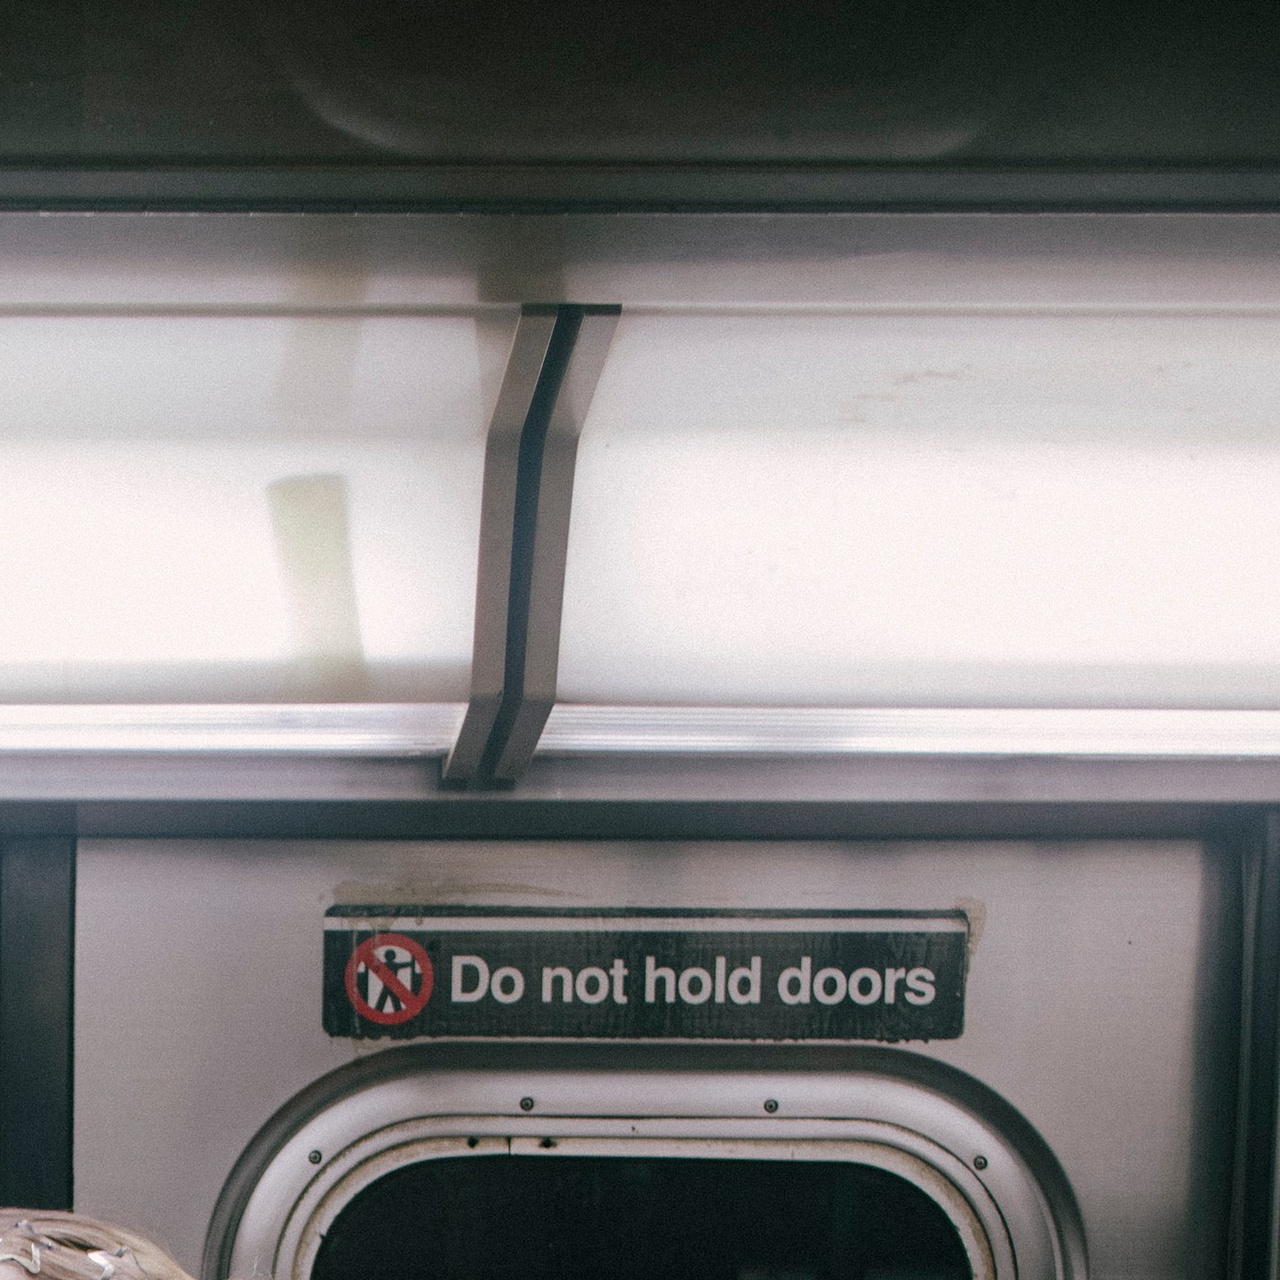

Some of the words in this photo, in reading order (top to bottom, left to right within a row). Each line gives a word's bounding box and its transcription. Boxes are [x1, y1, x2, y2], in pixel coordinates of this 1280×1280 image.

[451, 955, 525, 1004] Do
[541, 959, 629, 1004] not
[645, 955, 762, 1005] hold
[777, 956, 937, 1006] doors
